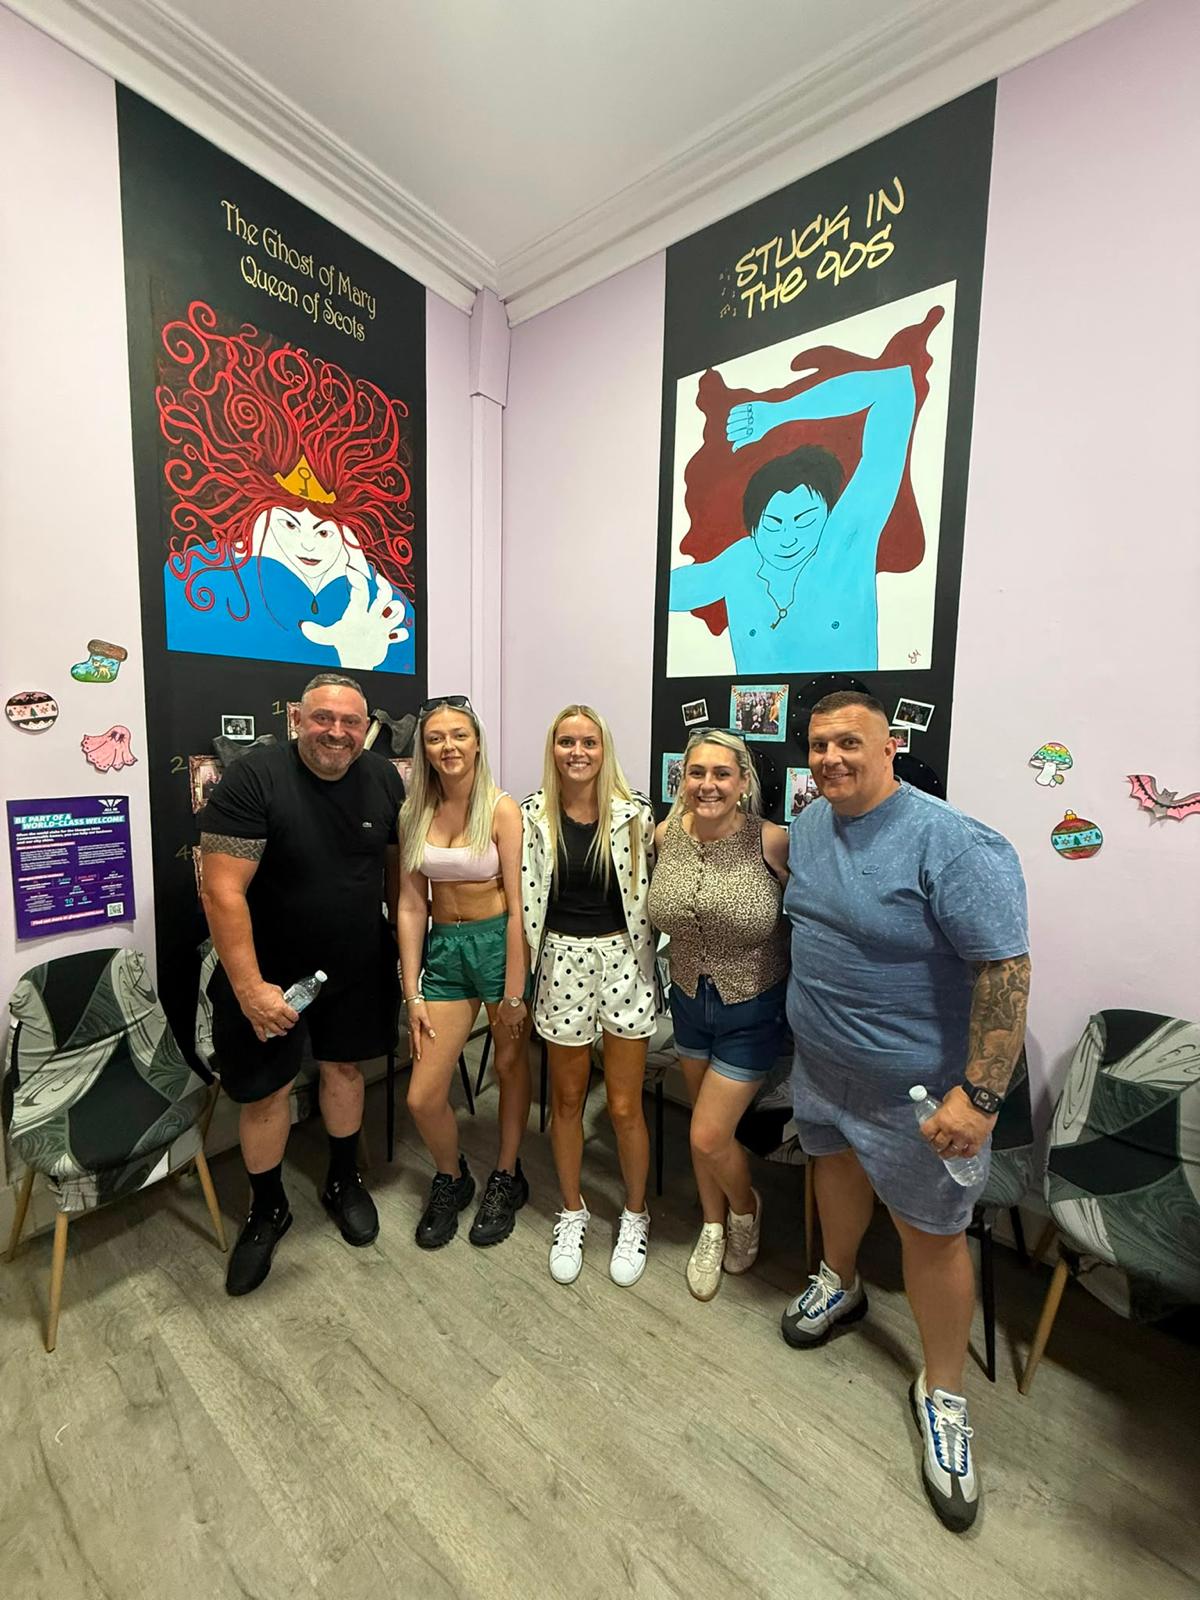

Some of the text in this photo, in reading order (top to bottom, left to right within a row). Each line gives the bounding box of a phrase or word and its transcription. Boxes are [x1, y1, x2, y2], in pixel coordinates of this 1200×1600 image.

[735, 176, 905, 287] STUCK IN
[221, 200, 376, 320] The Ghost of Mary
[240, 255, 366, 342] Queen of Scots
[271, 701, 285, 715] 1
[170, 756, 188, 774] 2
[15, 816, 27, 824] BE
[22, 815, 125, 830] WORLD-CLASS WELCOME
[175, 844, 191, 860] 4
